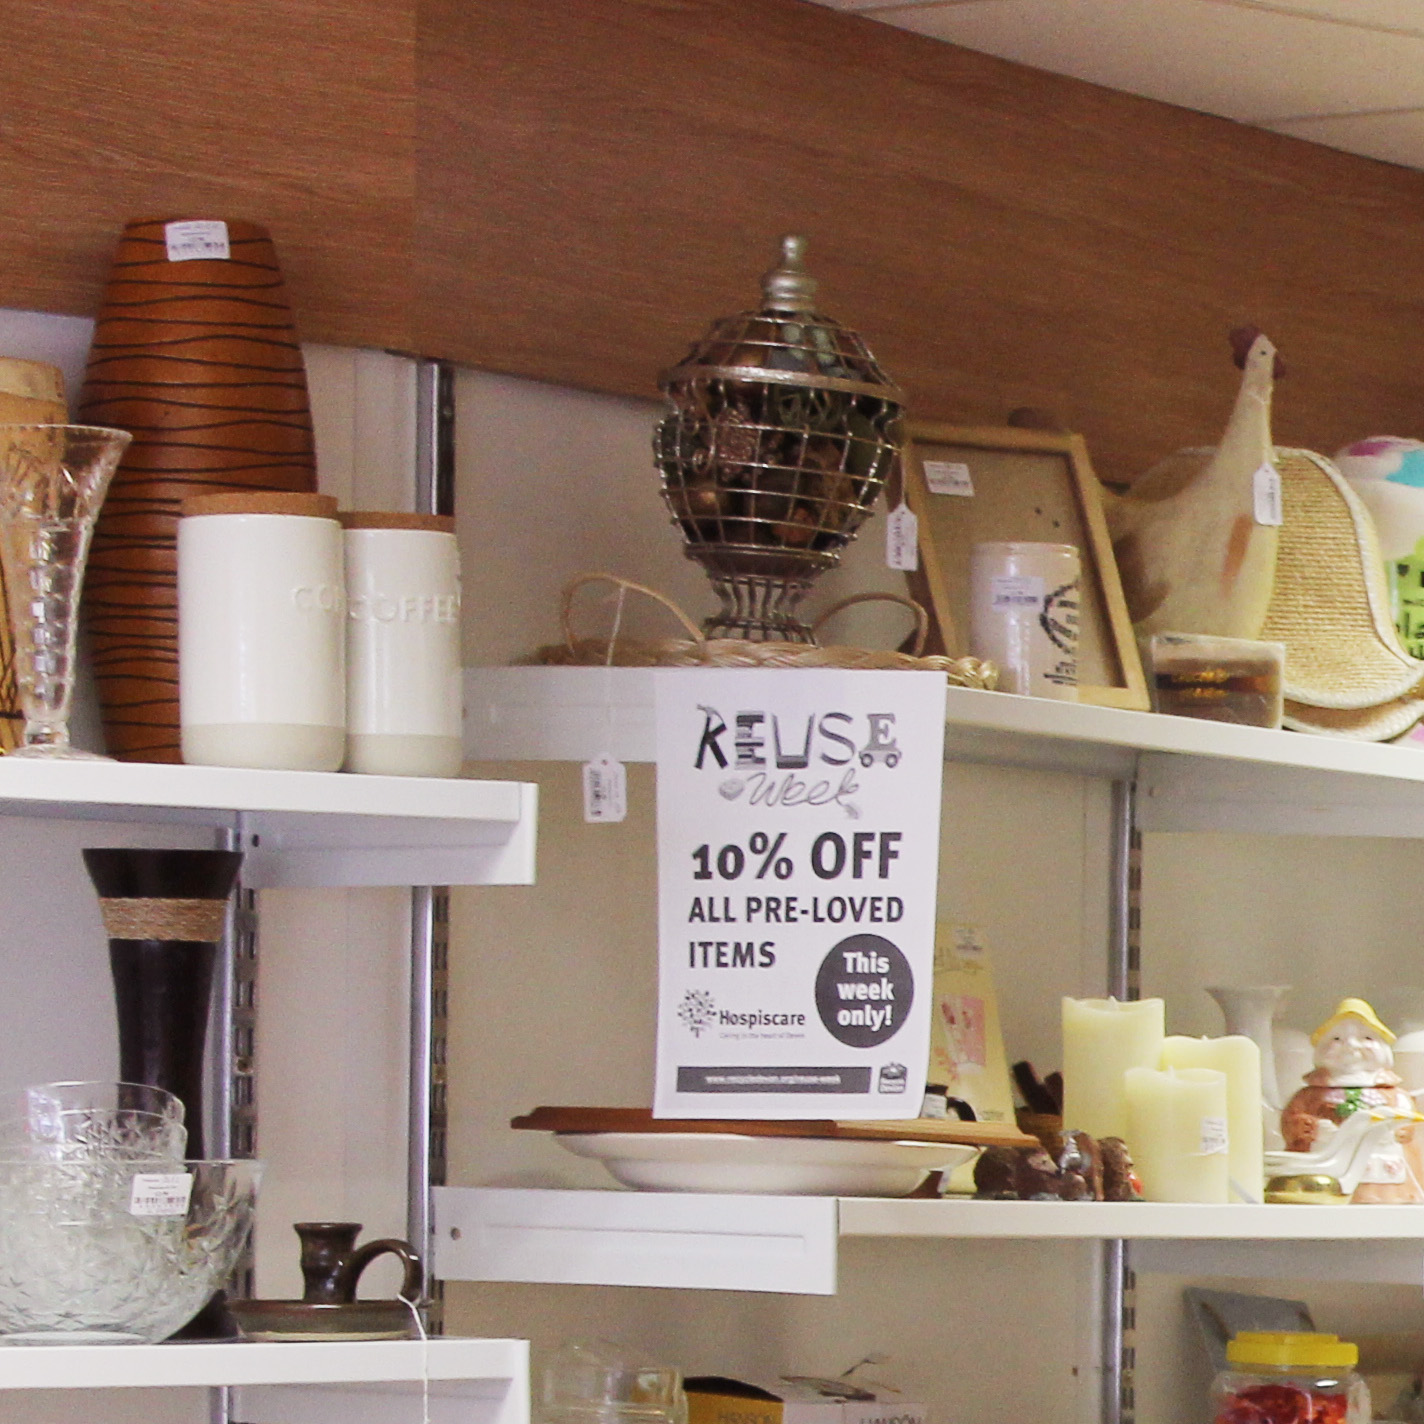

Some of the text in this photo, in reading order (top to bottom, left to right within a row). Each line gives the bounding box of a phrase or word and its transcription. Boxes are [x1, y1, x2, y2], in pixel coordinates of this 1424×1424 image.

[694, 704, 902, 770] REUSE
[746, 769, 861, 814] Week
[692, 831, 903, 880] 10% OFF
[688, 896, 904, 924] ALL PRE-LOVED
[688, 941, 777, 969] ITEMS
[842, 951, 890, 974] This
[837, 978, 895, 1001] week
[718, 1009, 806, 1028] Hospiscare
[837, 1004, 893, 1032] only!
